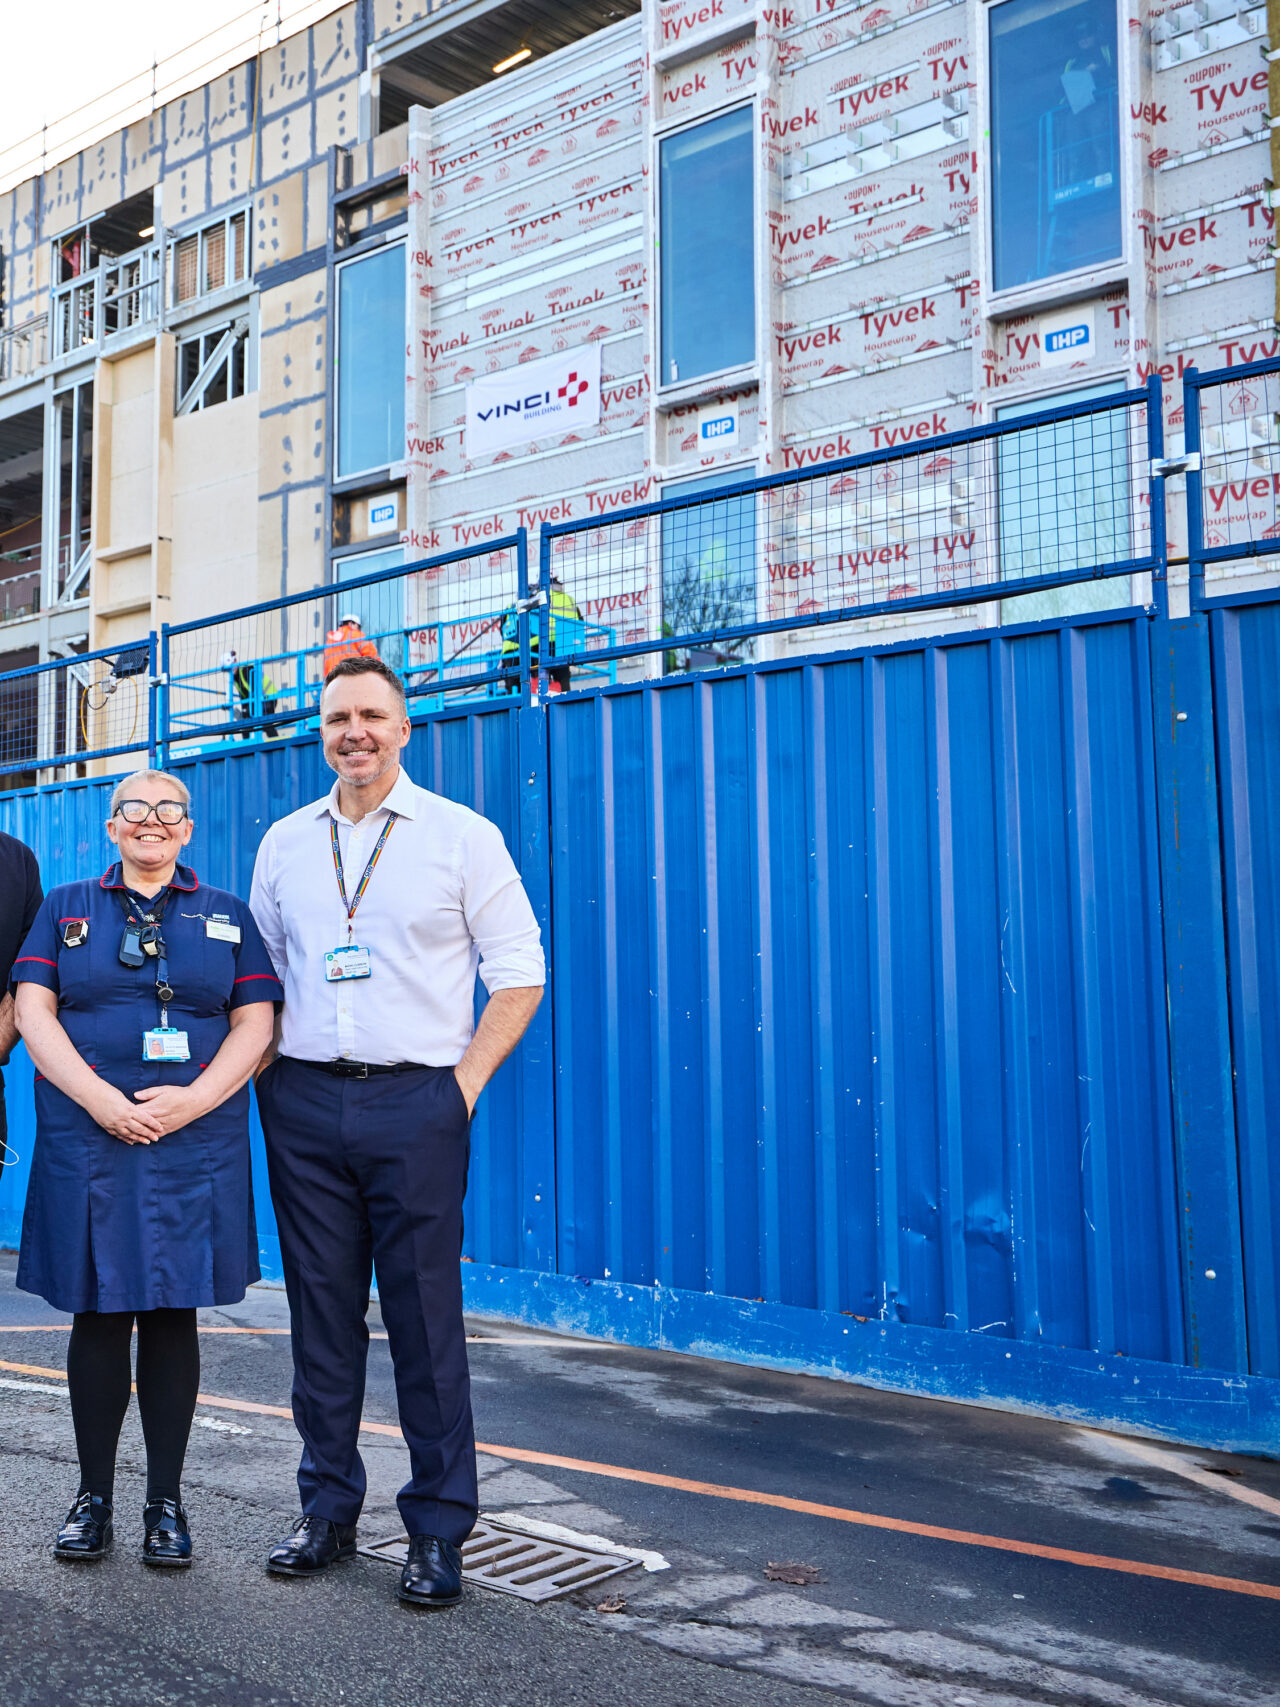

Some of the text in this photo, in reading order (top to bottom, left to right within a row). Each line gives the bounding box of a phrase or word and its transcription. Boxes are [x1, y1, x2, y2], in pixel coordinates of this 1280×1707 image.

[662, 0, 724, 39] Tyvek
[927, 40, 957, 56] DUPONT
[834, 74, 862, 91] DUPONT
[1189, 63, 1227, 83] DUPONT
[838, 76, 909, 116] Tyvek
[1190, 71, 1269, 112] Tyve
[761, 106, 818, 139] Tyvek
[1198, 102, 1267, 130] Housewrap
[1209, 135, 1220, 145] 15
[848, 187, 876, 201] DUPONT
[579, 205, 619, 226] Housewrap
[769, 215, 831, 254] Tyvek
[854, 219, 906, 241] Housewrap
[1138, 217, 1217, 259] Tyvek
[859, 297, 936, 338] Tyvek
[422, 332, 470, 362] Tyvek
[776, 324, 841, 362] Tyvek
[864, 333, 917, 353] Housewrap
[1052, 329, 1085, 350] IHP
[477, 391, 550, 422] VINCI
[1238, 396, 1250, 404] 15
[524, 405, 562, 421] BUILDING
[707, 419, 732, 437] IHP
[870, 413, 947, 448] Tyvek
[781, 435, 851, 469] Tyvek
[374, 507, 393, 522] IHP
[452, 515, 503, 545] Tyvek
[516, 500, 572, 529] Tyvek
[586, 482, 644, 514] Tyvek
[1208, 536, 1219, 546] 15
